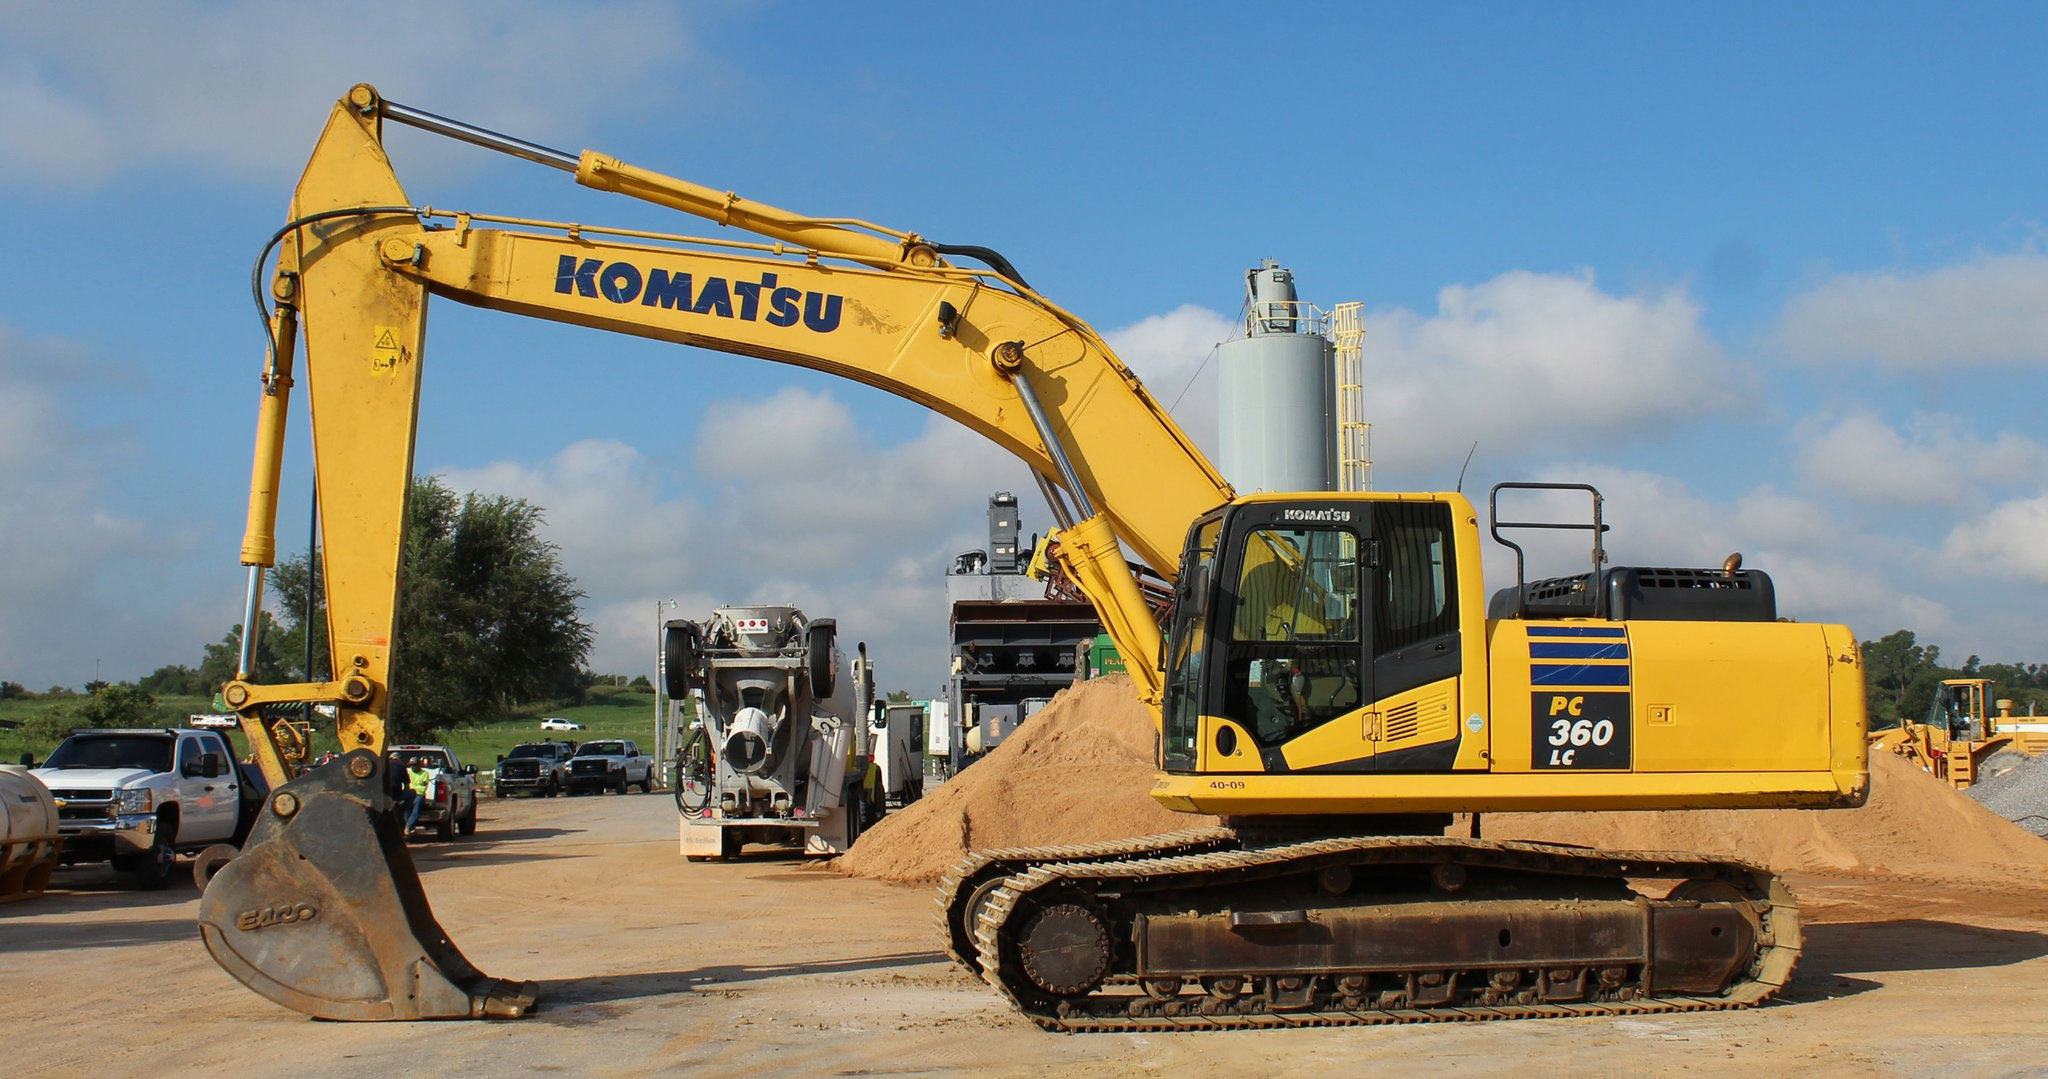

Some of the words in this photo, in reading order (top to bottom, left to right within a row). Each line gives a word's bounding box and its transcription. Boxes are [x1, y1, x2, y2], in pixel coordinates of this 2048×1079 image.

[554, 254, 844, 333] KOMATSU
[1284, 508, 1351, 521] KOMATSU
[1549, 696, 1584, 716] PC
[1548, 719, 1614, 747] 360
[1549, 749, 1575, 766] LC
[1210, 781, 1245, 790] 40-09
